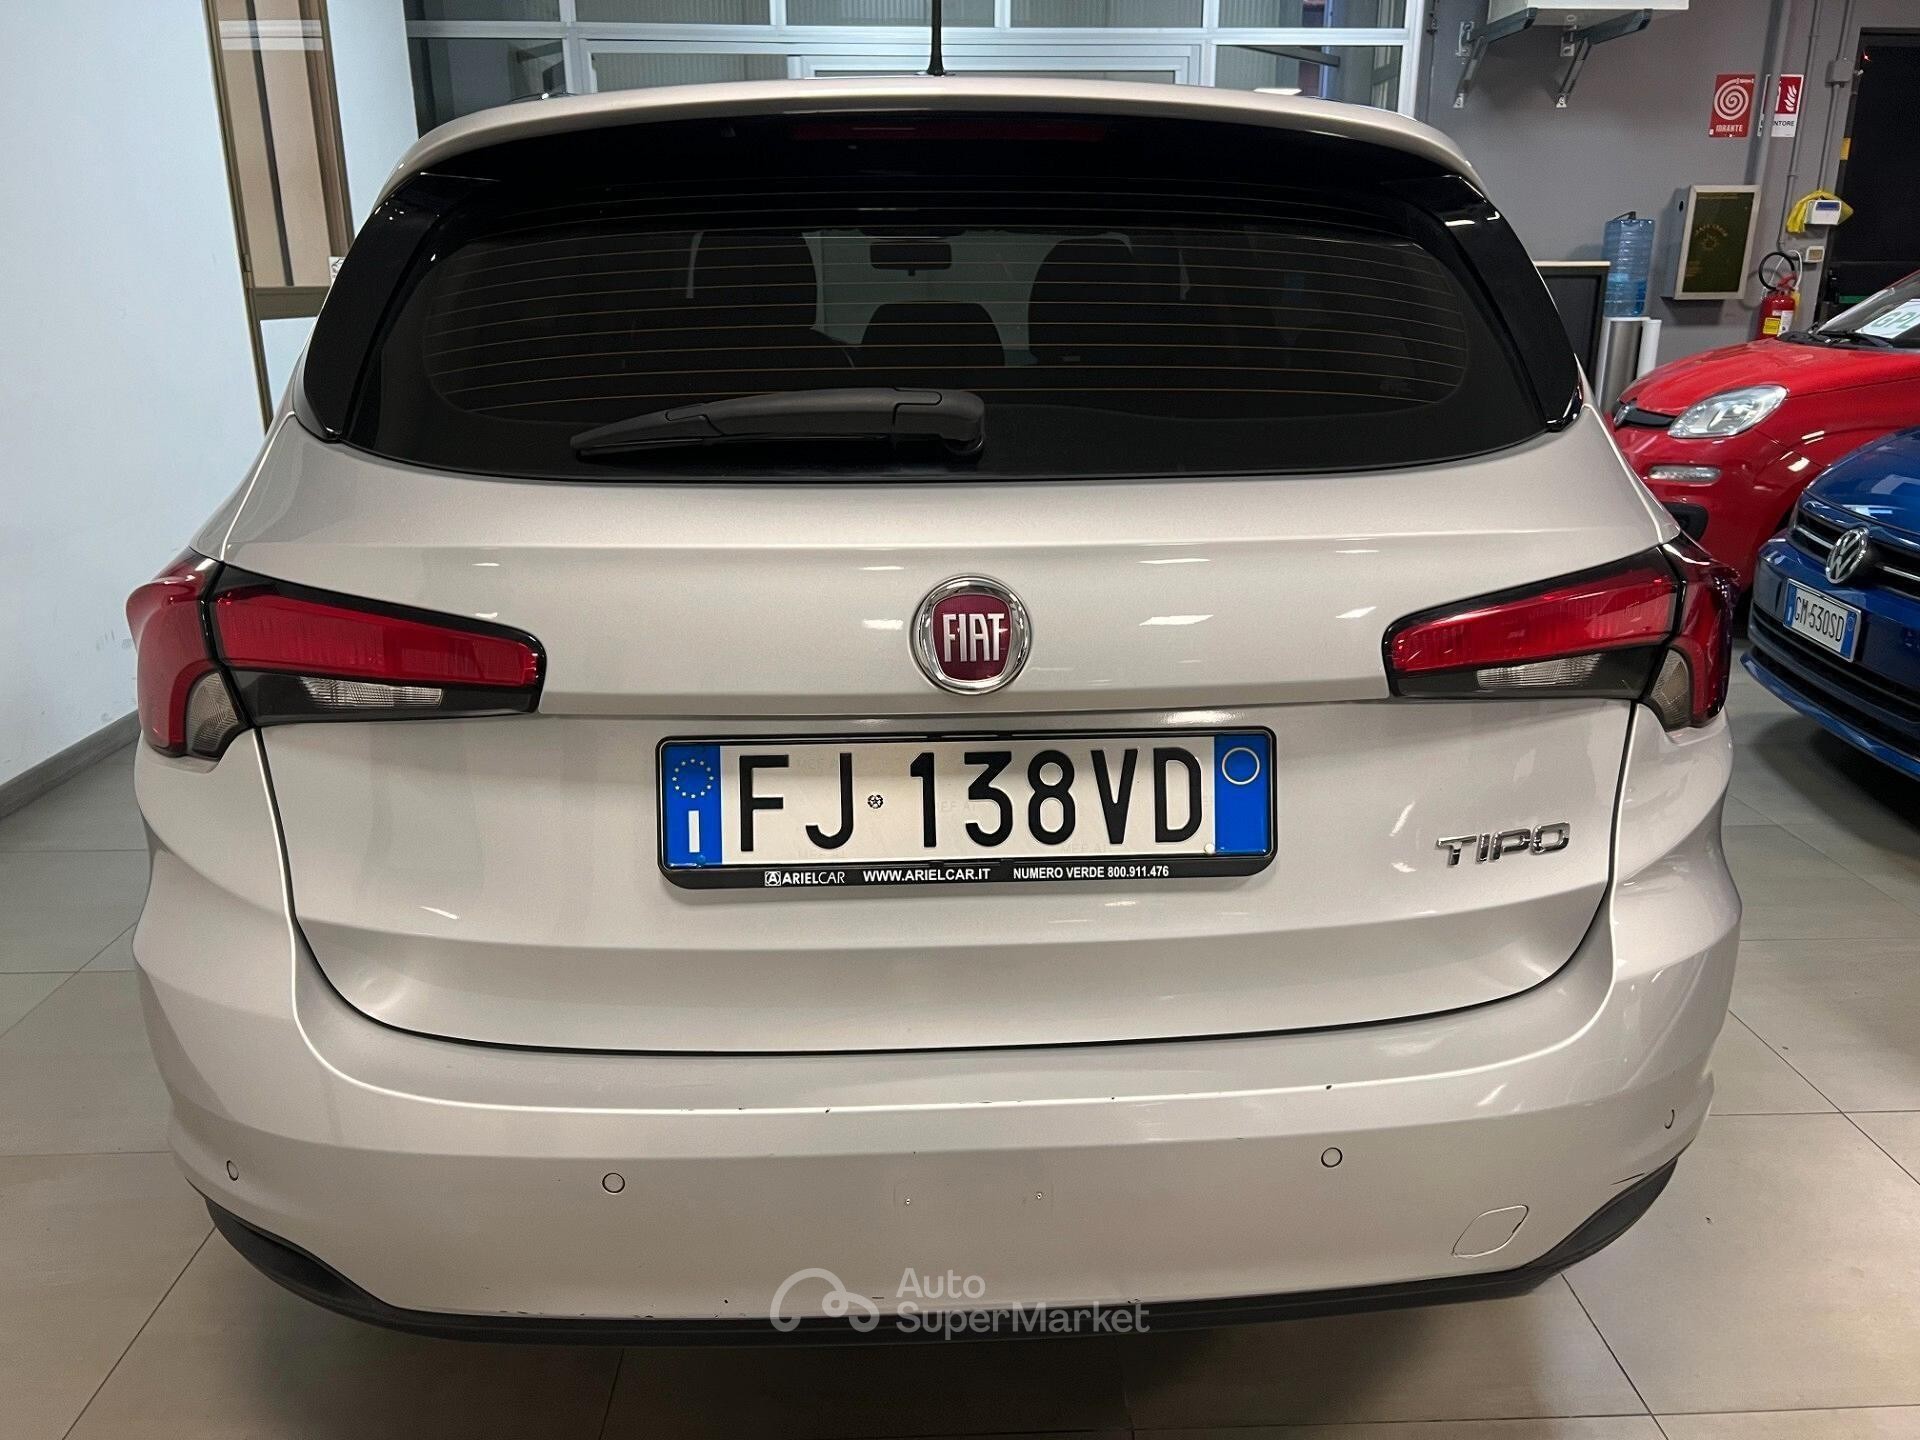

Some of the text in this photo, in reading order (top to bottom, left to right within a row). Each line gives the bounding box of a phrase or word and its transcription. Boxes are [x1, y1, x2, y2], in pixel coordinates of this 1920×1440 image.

[1715, 124, 1743, 132] IDRANTE
[942, 613, 1006, 662] FIAT
[1436, 822, 1571, 868] TIPO
[782, 871, 846, 885] ARIELCAR
[863, 868, 991, 882] WWW.ARIELCAR.IT
[1013, 865, 1169, 879] NUMERO VERDE 800.911.476
